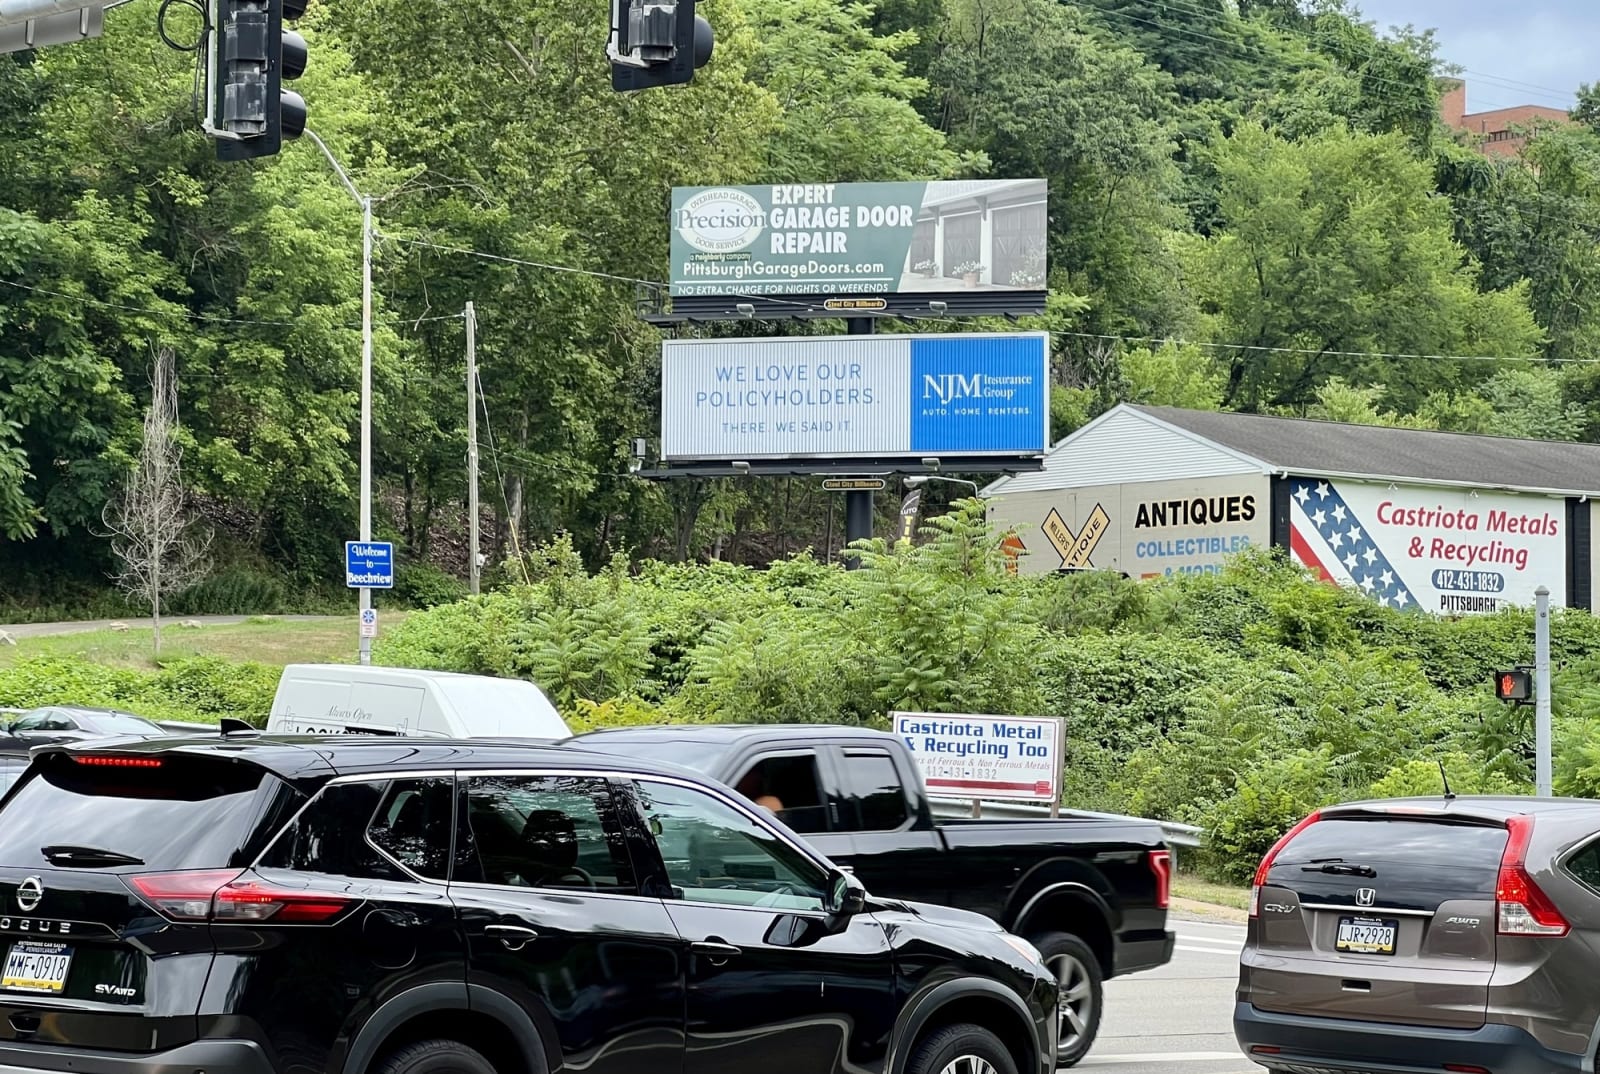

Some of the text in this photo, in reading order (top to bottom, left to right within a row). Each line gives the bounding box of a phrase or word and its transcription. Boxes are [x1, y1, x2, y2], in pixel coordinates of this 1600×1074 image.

[690, 191, 757, 212] OVERHEAD GARAGE
[772, 184, 835, 204] EXPERT
[676, 208, 767, 229] Precision
[770, 205, 913, 229] GARAGE DOOR
[695, 237, 748, 250] DOOR SERVICE
[770, 232, 847, 254] REPAIR
[683, 260, 884, 279] PittsburghGarageDoors.com
[679, 283, 888, 295] NO EXTRA CHARGE FOR NIGHTS OR WEEKENDS
[716, 363, 862, 382] WE LOVE OUR
[696, 388, 880, 407] POLICYHOLDERS.
[922, 374, 1032, 405] NJM Insurance
[984, 387, 1014, 400] Group
[776, 421, 796, 433] WE
[801, 421, 833, 432] SAID
[1135, 495, 1255, 529] ANTIQUES
[1377, 501, 1558, 536] Castriota Metals
[1049, 521, 1070, 551] MILLER'S
[351, 545, 387, 557] Welcome
[1136, 535, 1250, 558] COLLECTIBLES
[1408, 536, 1528, 571] & Recycling
[366, 560, 374, 568] to
[348, 572, 392, 584] Beechview
[1441, 594, 1496, 612] PITTSBURGH
[900, 719, 984, 737] Castriota
[905, 737, 1047, 759] & Recycling Too
[937, 757, 965, 767] Ferrous
[968, 759, 974, 767] &
[978, 759, 993, 768] Non
[994, 760, 1023, 769] Ferrous
[1025, 761, 1050, 770] Metals
[1445, 916, 1480, 925] AWD
